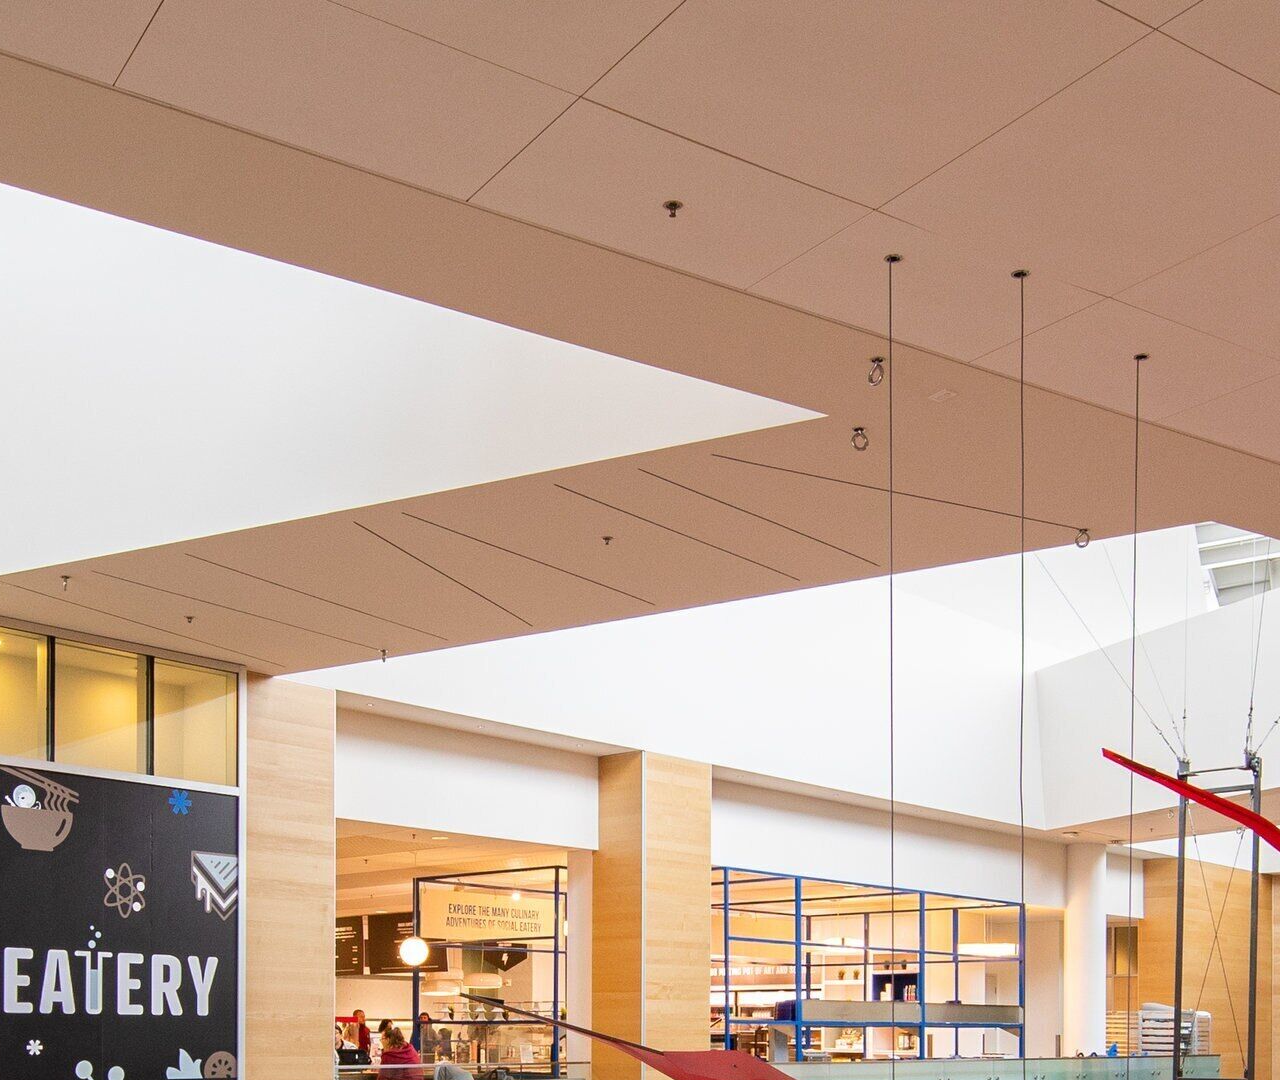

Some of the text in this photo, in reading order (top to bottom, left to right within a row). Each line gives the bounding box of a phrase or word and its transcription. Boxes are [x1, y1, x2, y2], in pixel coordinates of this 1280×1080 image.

[448, 903, 540, 920] EXPLORE THE MANY CULINARY
[445, 916, 487, 929] ADVENTURES
[519, 922, 542, 933] EATERY
[3, 947, 219, 1016] EATERY
